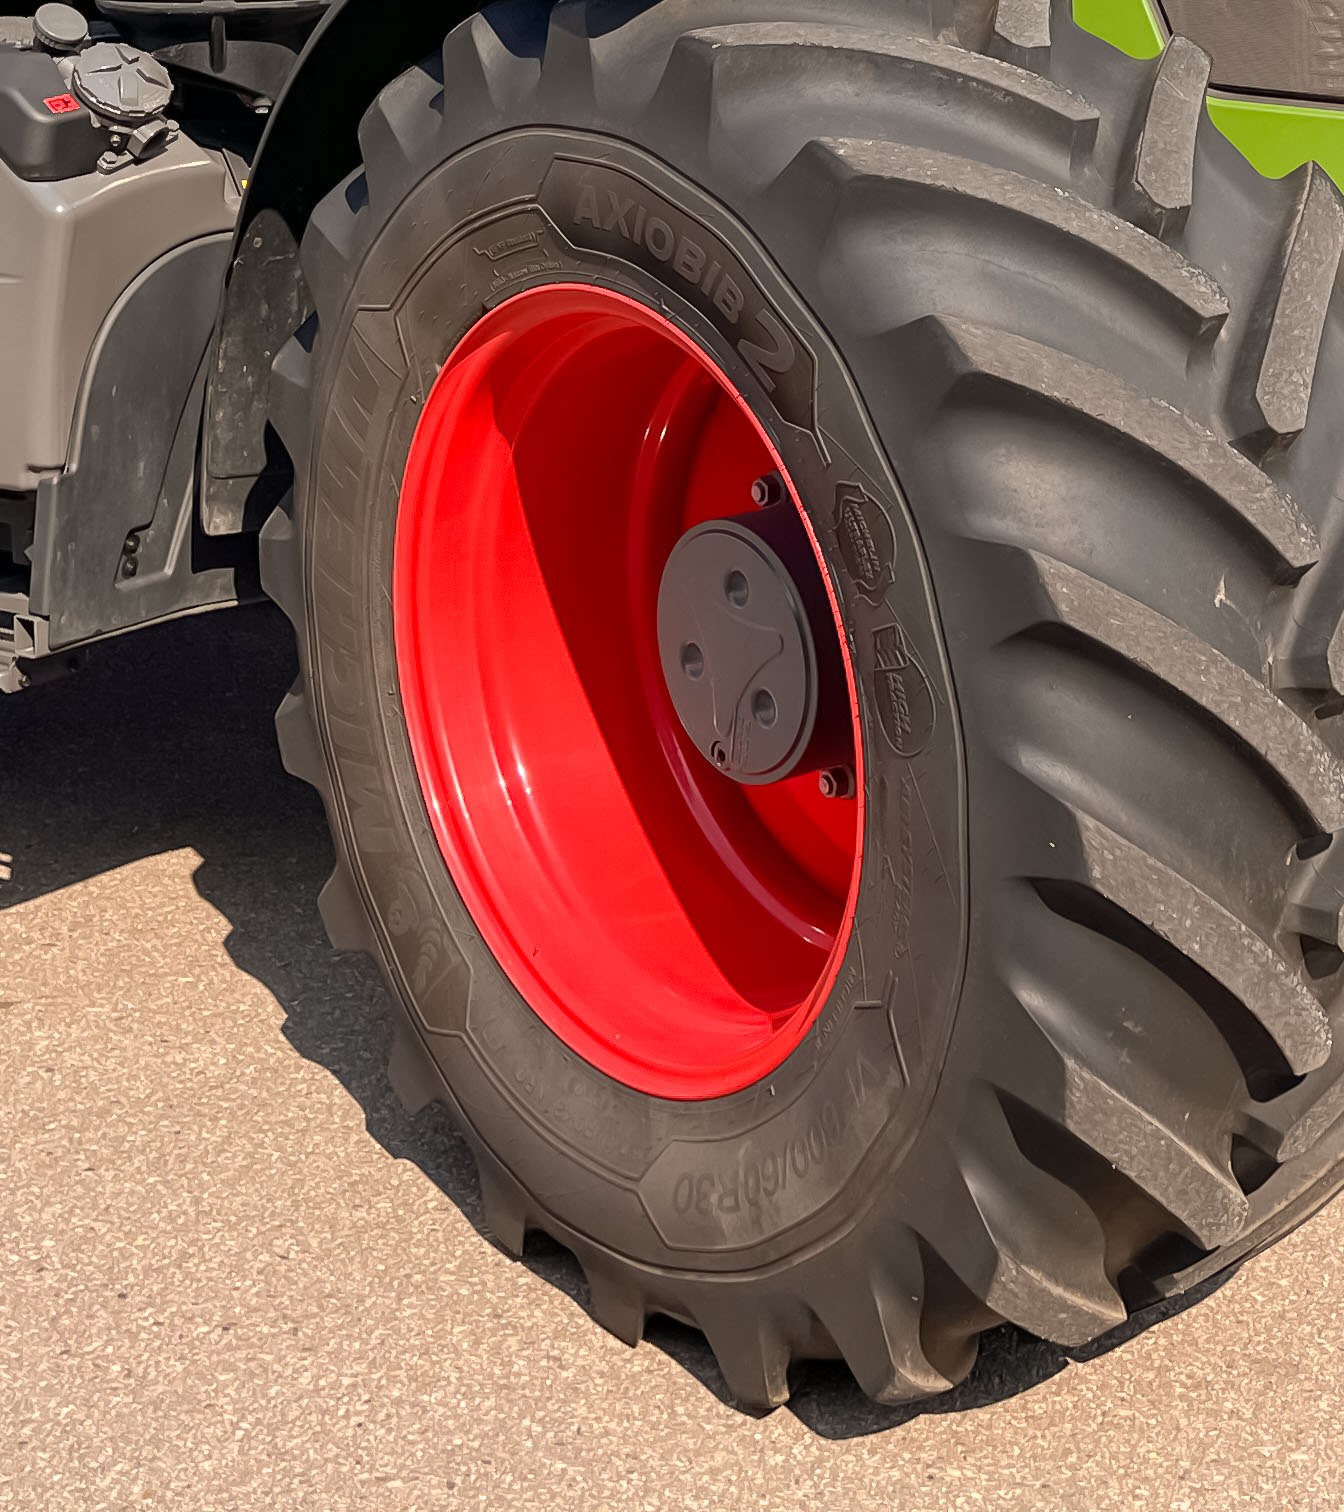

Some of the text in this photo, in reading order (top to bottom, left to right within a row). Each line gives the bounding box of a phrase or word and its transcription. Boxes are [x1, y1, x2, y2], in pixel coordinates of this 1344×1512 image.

[573, 182, 796, 393] AXIOBIB 2
[851, 502, 882, 573] MICHELIN
[892, 672, 912, 735] HIGH
